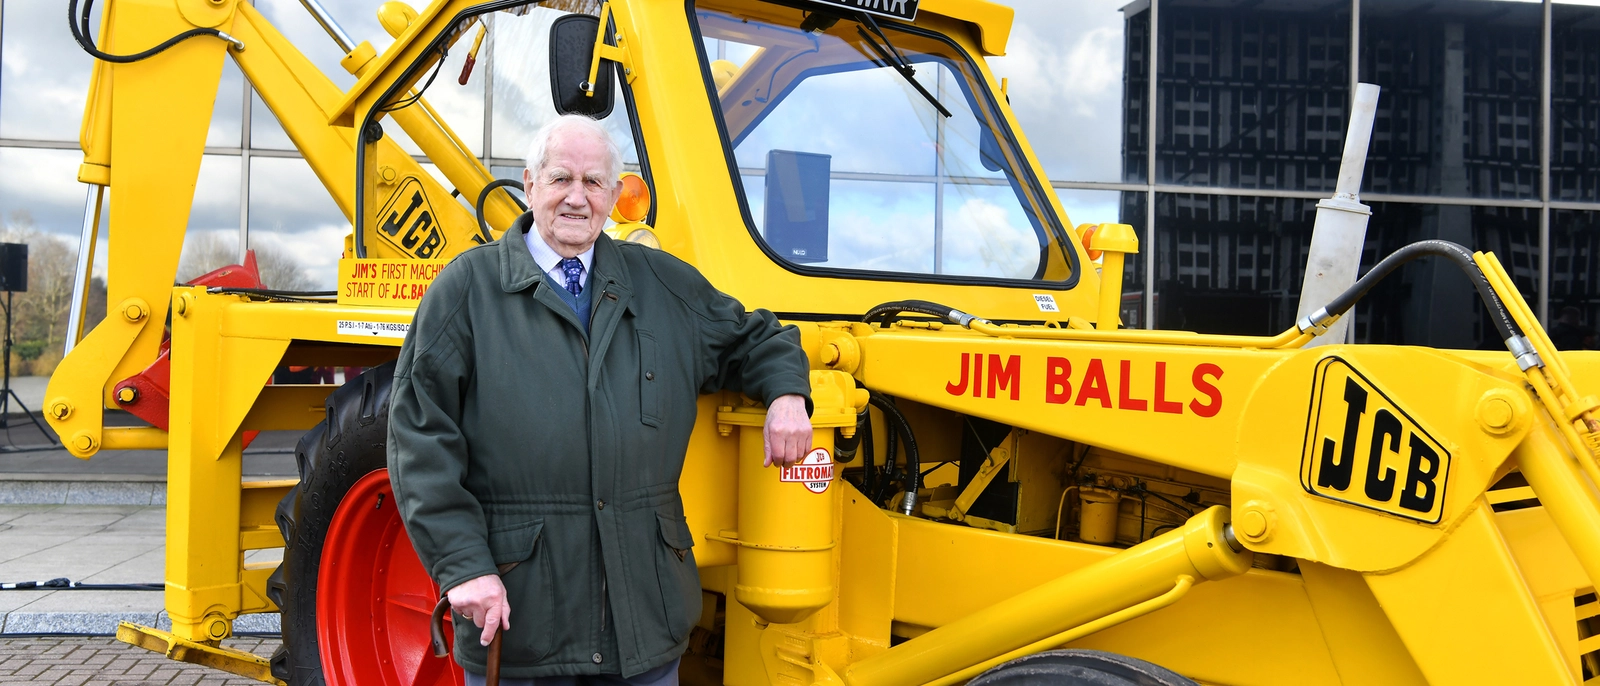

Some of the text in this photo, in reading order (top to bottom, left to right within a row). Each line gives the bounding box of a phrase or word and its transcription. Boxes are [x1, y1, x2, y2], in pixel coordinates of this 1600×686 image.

[381, 190, 440, 259] JCB
[352, 263, 377, 279] JIM'S
[382, 263, 408, 280] FIRST
[346, 282, 376, 298] START
[378, 283, 390, 299] OF
[1035, 295, 1053, 303] DIESEL
[1041, 303, 1055, 311] FUEL
[945, 352, 1225, 418] JIM BALLS
[1317, 375, 1440, 513] JCB
